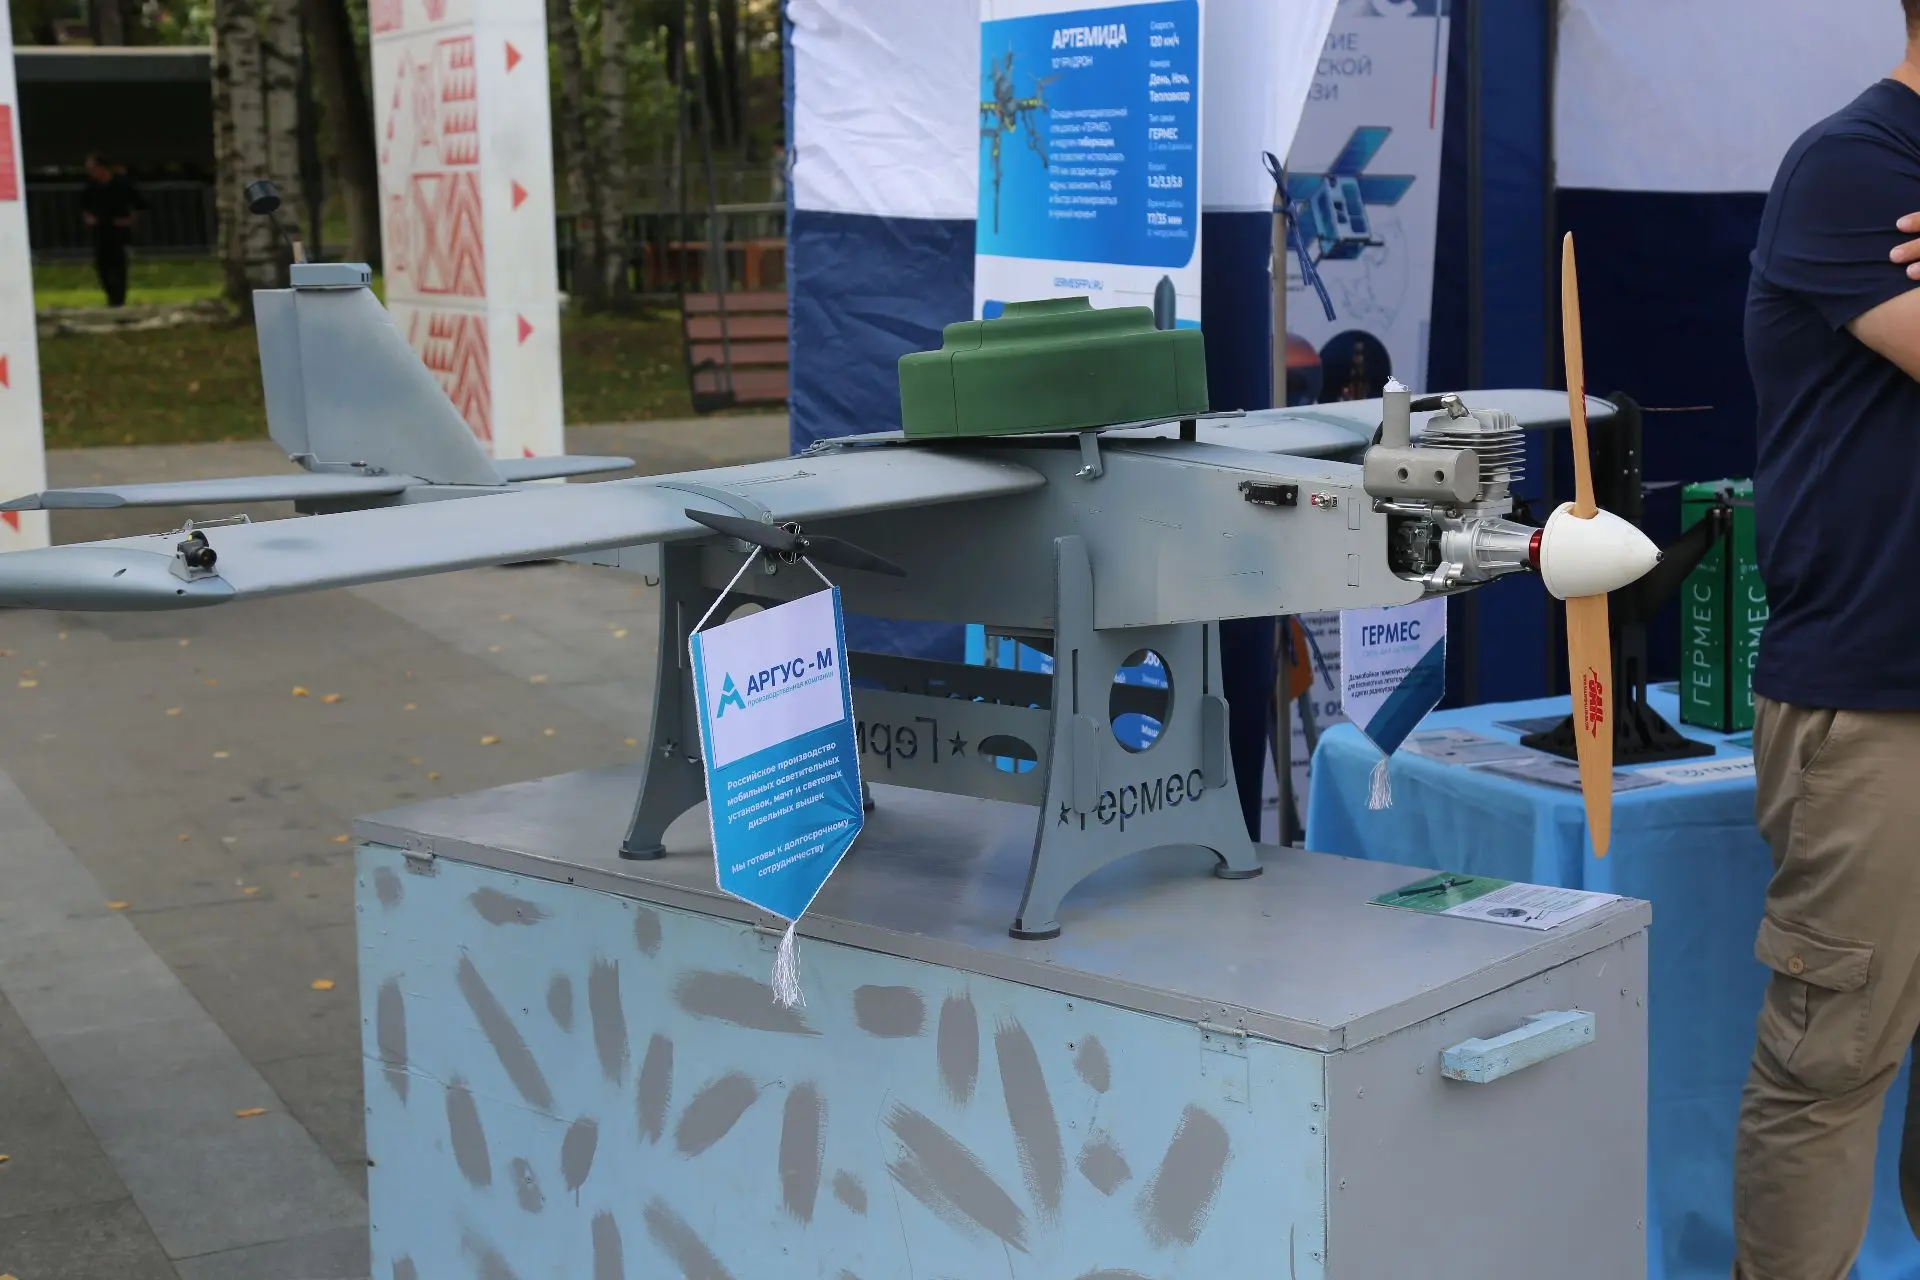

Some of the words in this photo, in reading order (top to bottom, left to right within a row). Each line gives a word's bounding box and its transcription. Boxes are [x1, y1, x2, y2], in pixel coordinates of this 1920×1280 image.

[1051, 24, 1128, 49] АРТЕМИДА
[1148, 127, 1178, 140] ГЕРМЕС
[1362, 620, 1421, 647] ГЕРМЕС
[1693, 584, 1711, 706] ГЕРМЕС
[748, 681, 804, 706] производственная
[805, 671, 834, 687] компании
[727, 765, 776, 791] Российское
[778, 742, 837, 770] производство
[727, 782, 775, 807] мобильных
[776, 756, 840, 786] осветительных
[728, 799, 773, 824] установок,
[773, 789, 794, 803] мачт
[795, 786, 802, 794] и
[803, 770, 843, 790] световых
[748, 804, 794, 830] дизельных
[795, 792, 825, 809] вышек
[731, 862, 746, 875] Мы
[747, 849, 776, 868] готовы
[777, 844, 783, 853] к
[784, 819, 849, 851] долгосрочному
[758, 843, 825, 877] сотрудничеству
